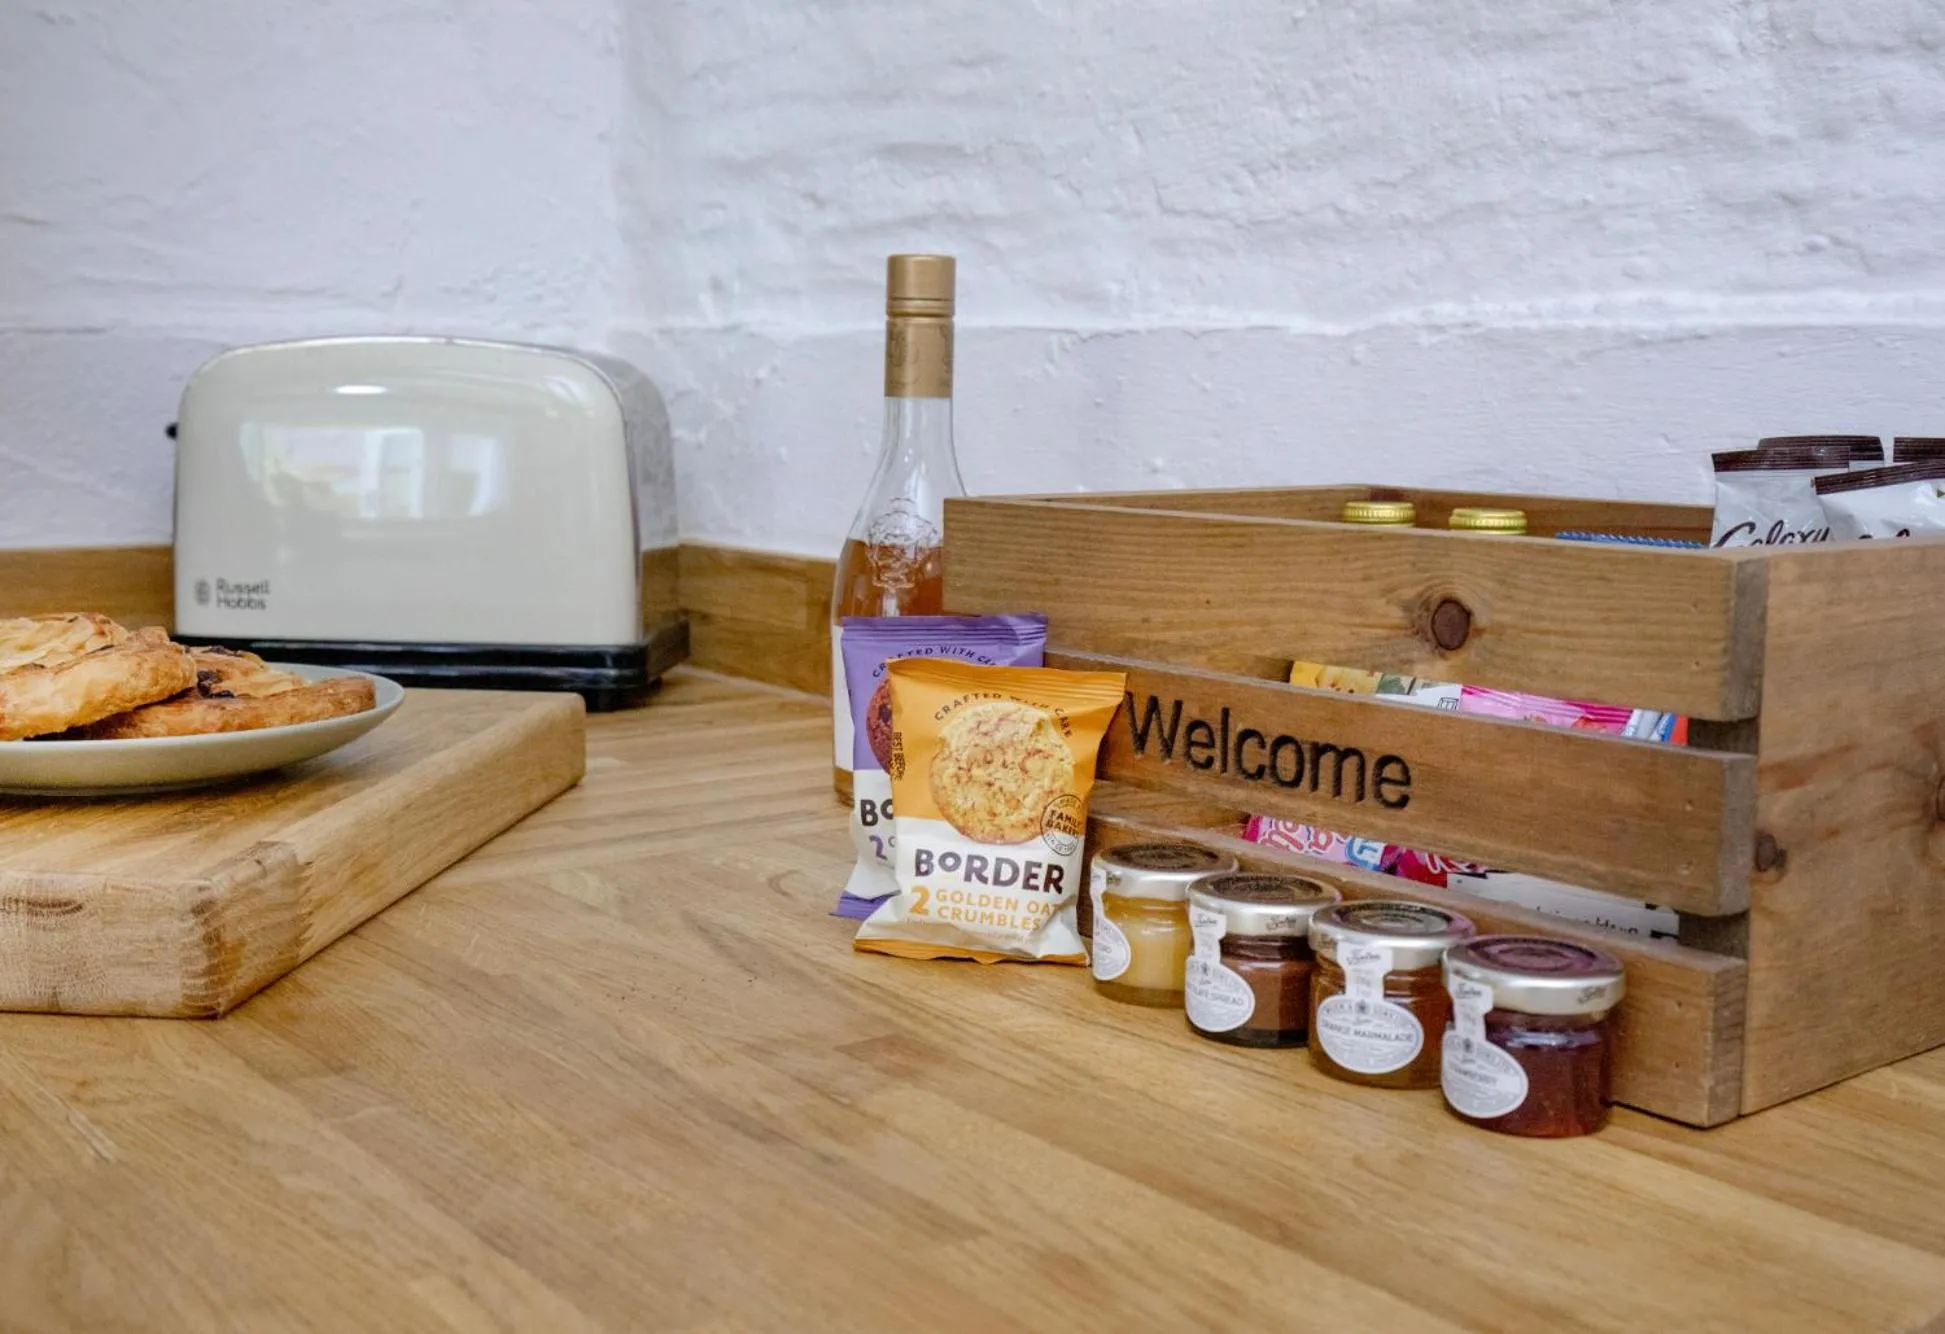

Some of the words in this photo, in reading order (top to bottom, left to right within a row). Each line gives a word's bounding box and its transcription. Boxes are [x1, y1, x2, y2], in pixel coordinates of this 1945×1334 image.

[216, 577, 270, 595] Russell
[216, 596, 266, 610] Hobbs
[872, 647, 933, 678] CRFTED
[940, 646, 975, 659] WITH
[934, 692, 1002, 721] CRAFTED
[1125, 690, 1412, 810] Welcome
[868, 834, 888, 861] 2
[915, 848, 1065, 895] BORDER
[909, 885, 930, 916] 2
[936, 888, 1018, 912] GOLDEN
[937, 905, 1041, 932] CRUMBLES
